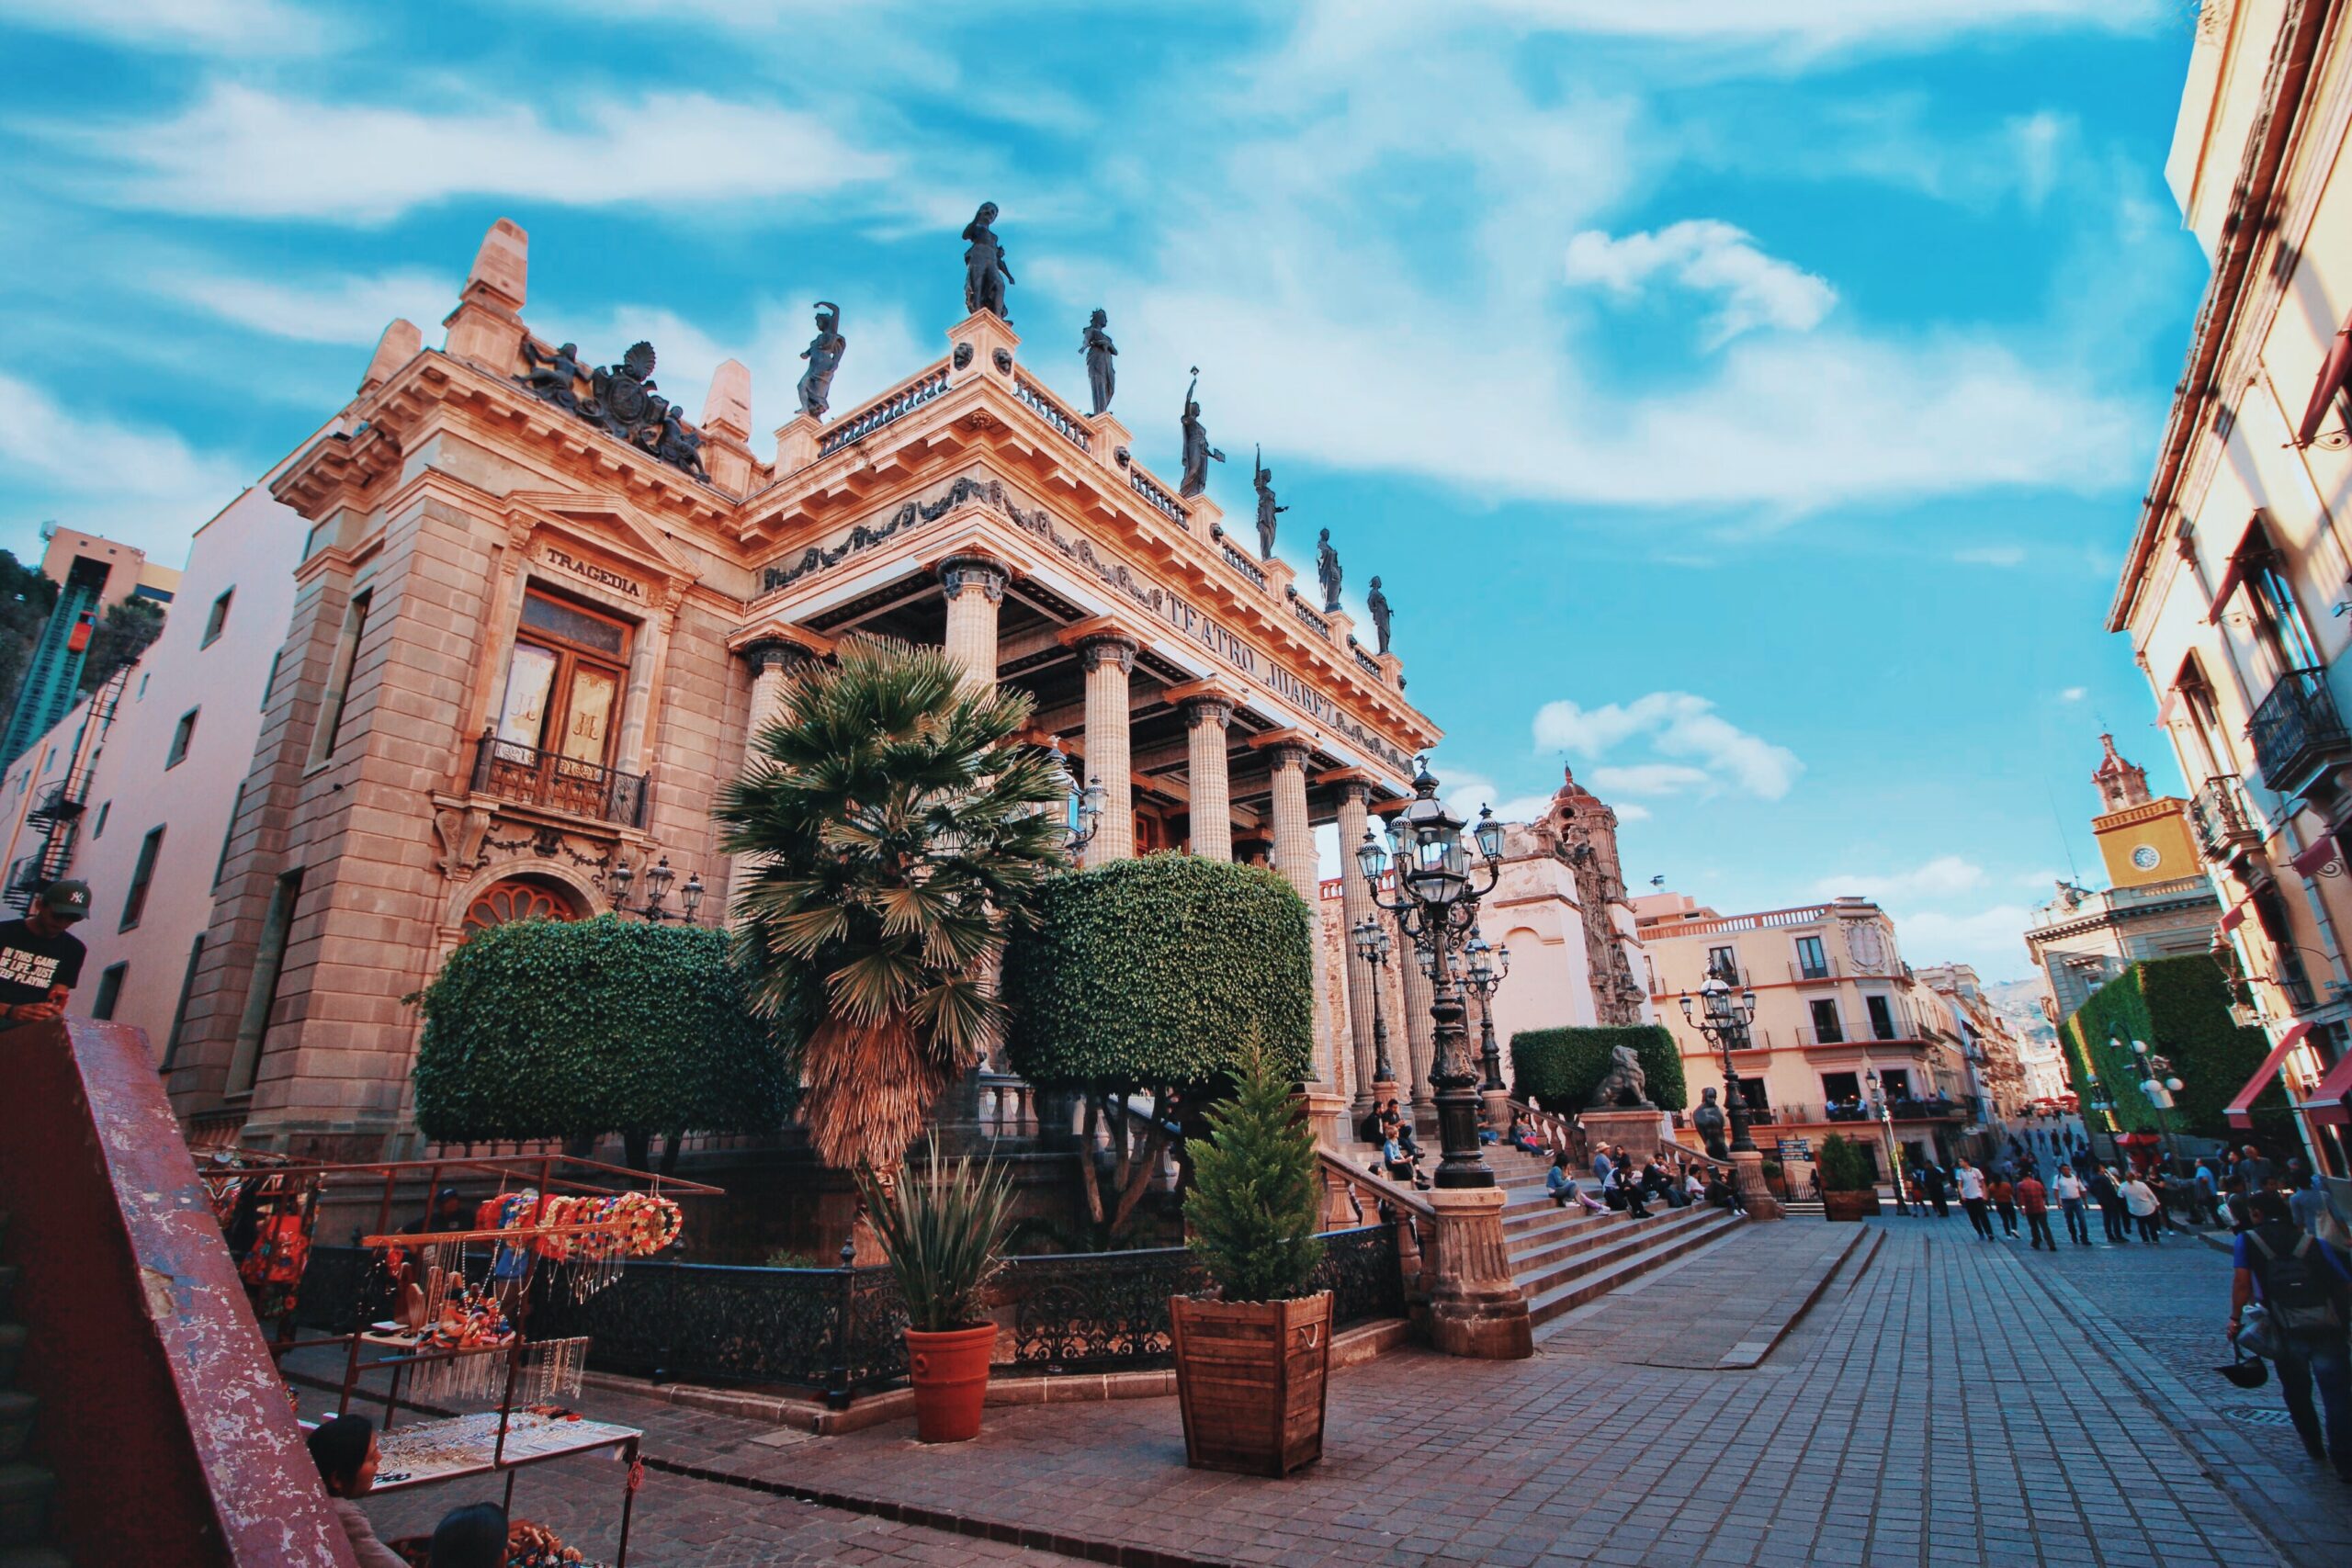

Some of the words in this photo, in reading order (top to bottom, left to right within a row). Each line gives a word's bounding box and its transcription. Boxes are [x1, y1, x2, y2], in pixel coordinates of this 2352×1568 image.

[547, 547, 640, 597] TRAGEDIA
[1166, 591, 1254, 673] TEATRO
[0, 956, 12, 967] OF
[30, 966, 55, 979] JUST
[2, 946, 15, 957] IN
[13, 950, 34, 963] THIS
[33, 955, 61, 969] GAME
[0, 967, 16, 980] EEP
[14, 973, 52, 988] PLAYING
